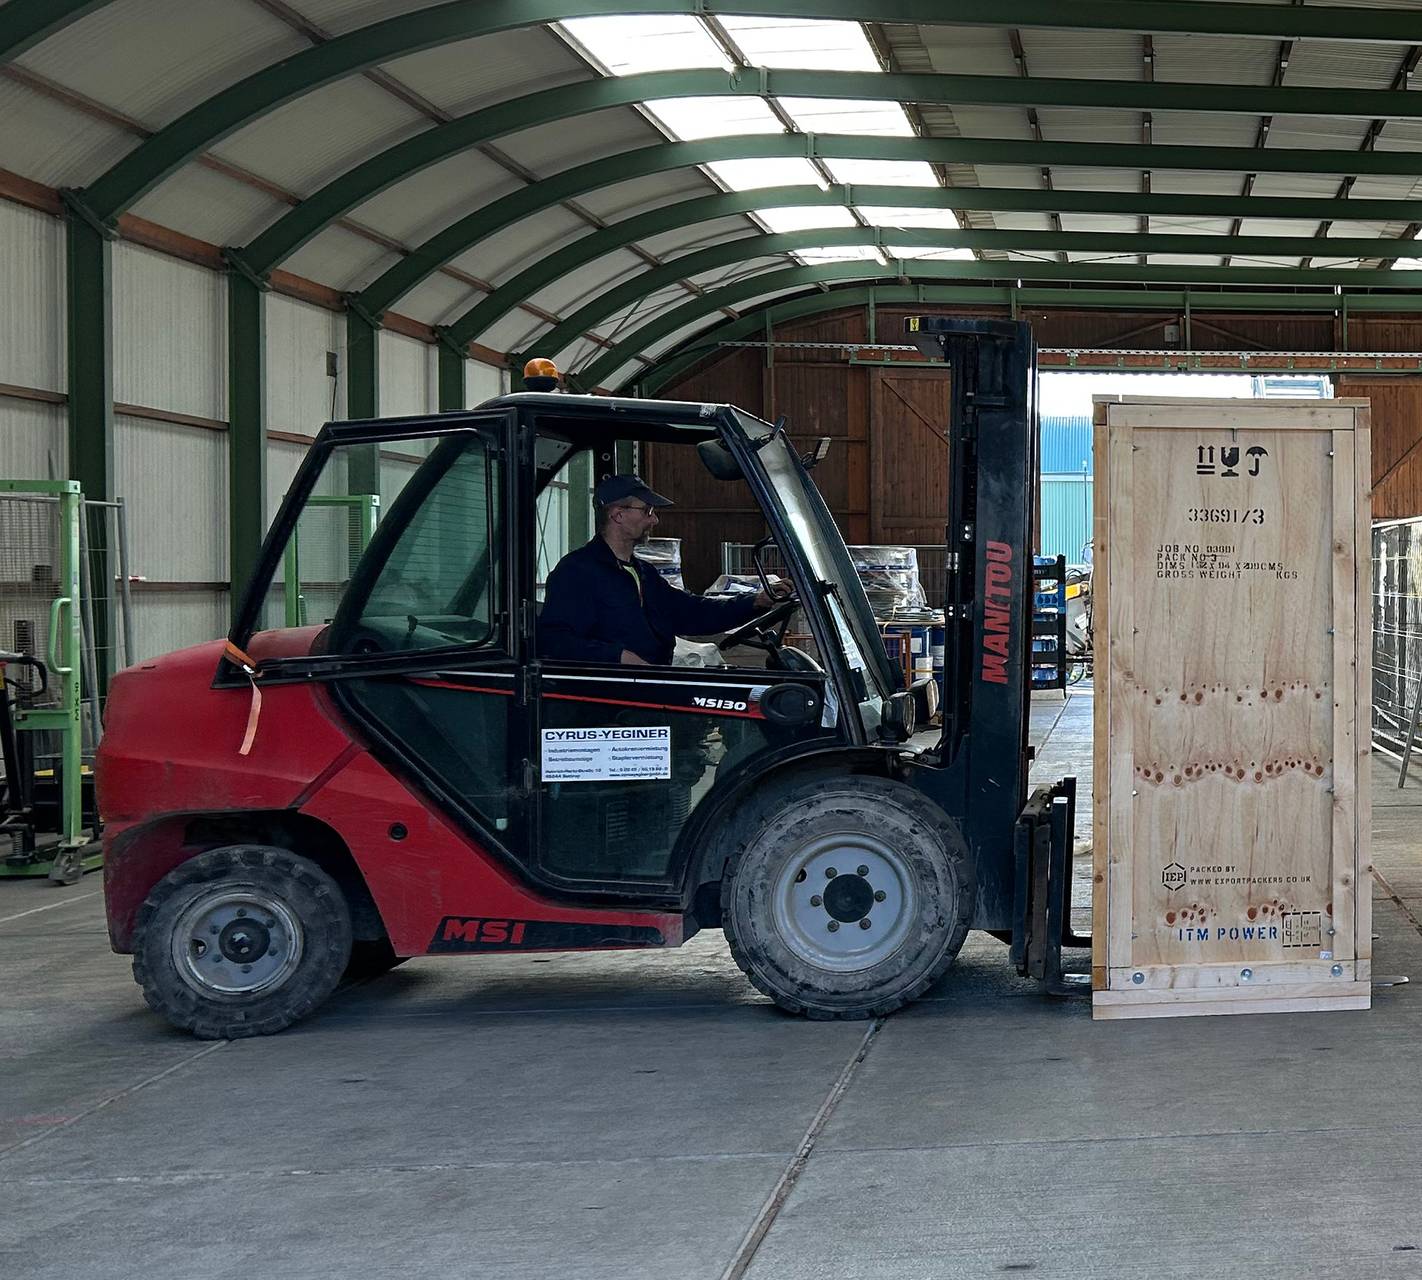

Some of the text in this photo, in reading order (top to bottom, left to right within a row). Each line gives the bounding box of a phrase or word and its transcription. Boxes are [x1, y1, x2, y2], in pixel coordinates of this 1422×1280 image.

[1188, 508, 1265, 525] 33691/3
[1157, 544, 1179, 553] JOB
[1157, 553, 1186, 562] PACK
[1157, 570, 1299, 579] GROSS WEIGHT KGS
[982, 540, 1013, 684] MANITOU
[545, 729, 669, 741] CYRUS-YEGINER
[1165, 872, 1184, 883] IEP
[443, 919, 527, 944] MSI
[1179, 928, 1209, 941] ITM
[1217, 926, 1278, 941] POWER
